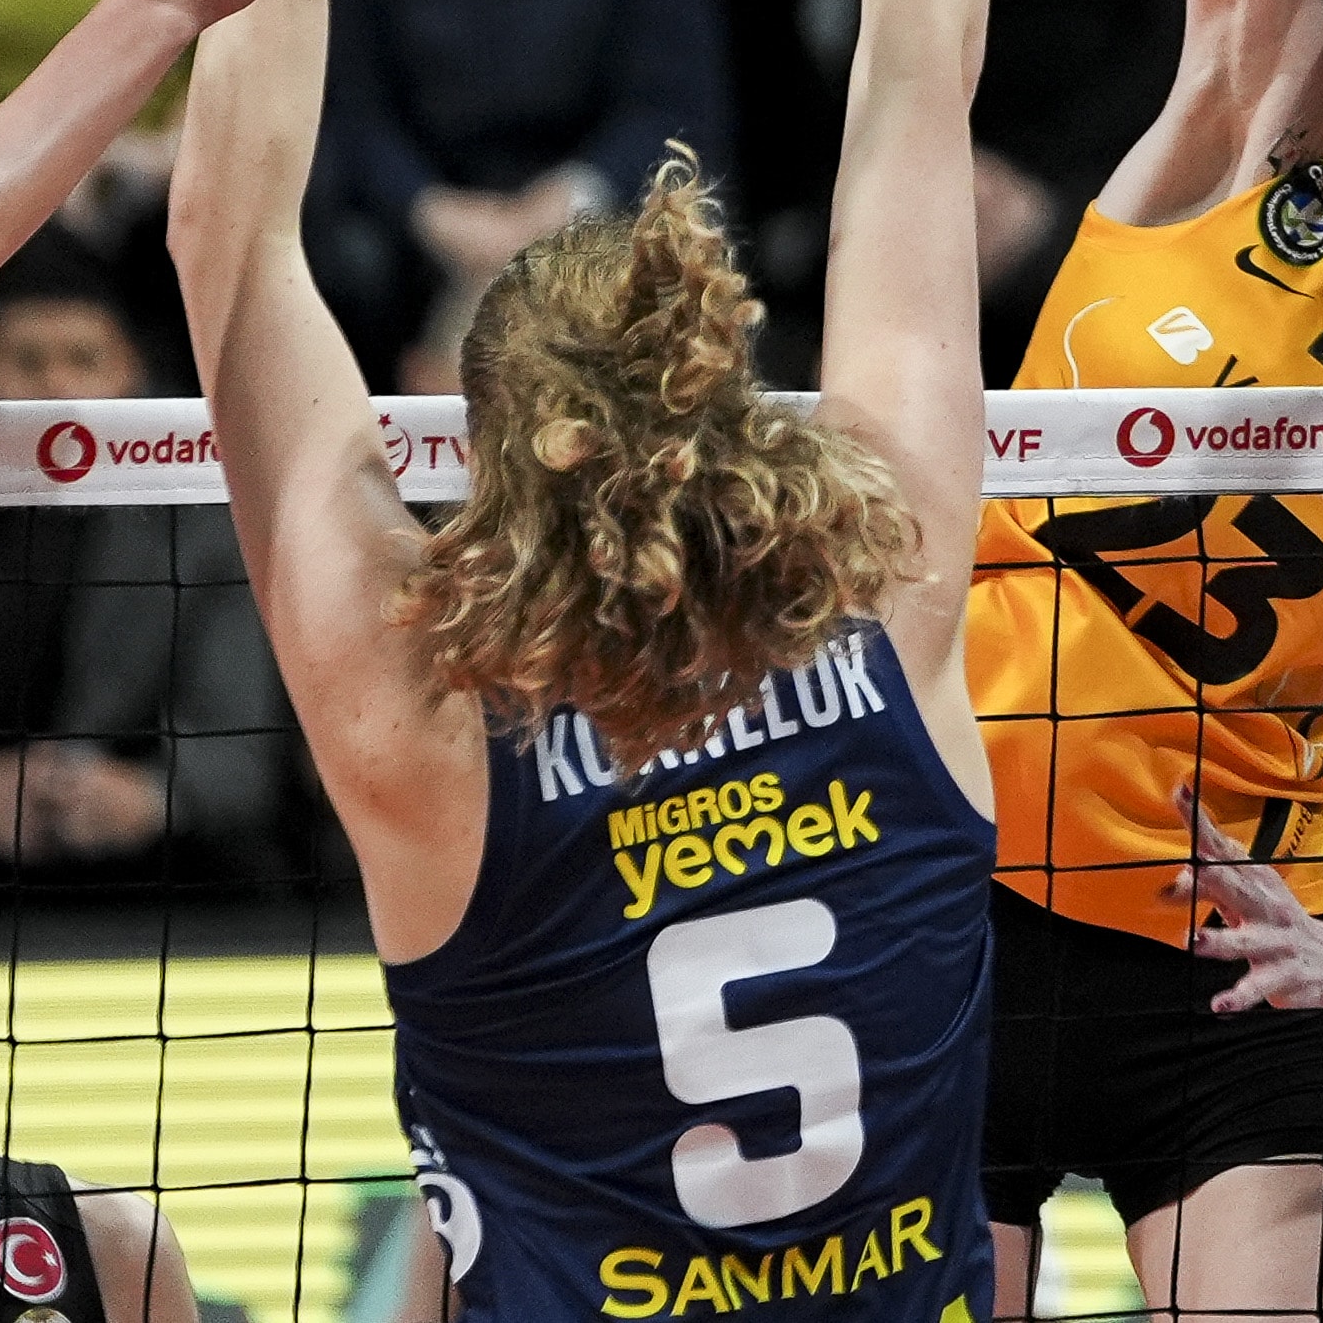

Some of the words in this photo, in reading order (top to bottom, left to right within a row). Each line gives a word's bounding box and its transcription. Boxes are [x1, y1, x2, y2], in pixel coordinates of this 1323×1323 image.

[986, 428, 1043, 463] VF
[614, 779, 880, 920] yemek
[646, 897, 865, 1230] 5
[599, 1196, 943, 1320] SANMAR
